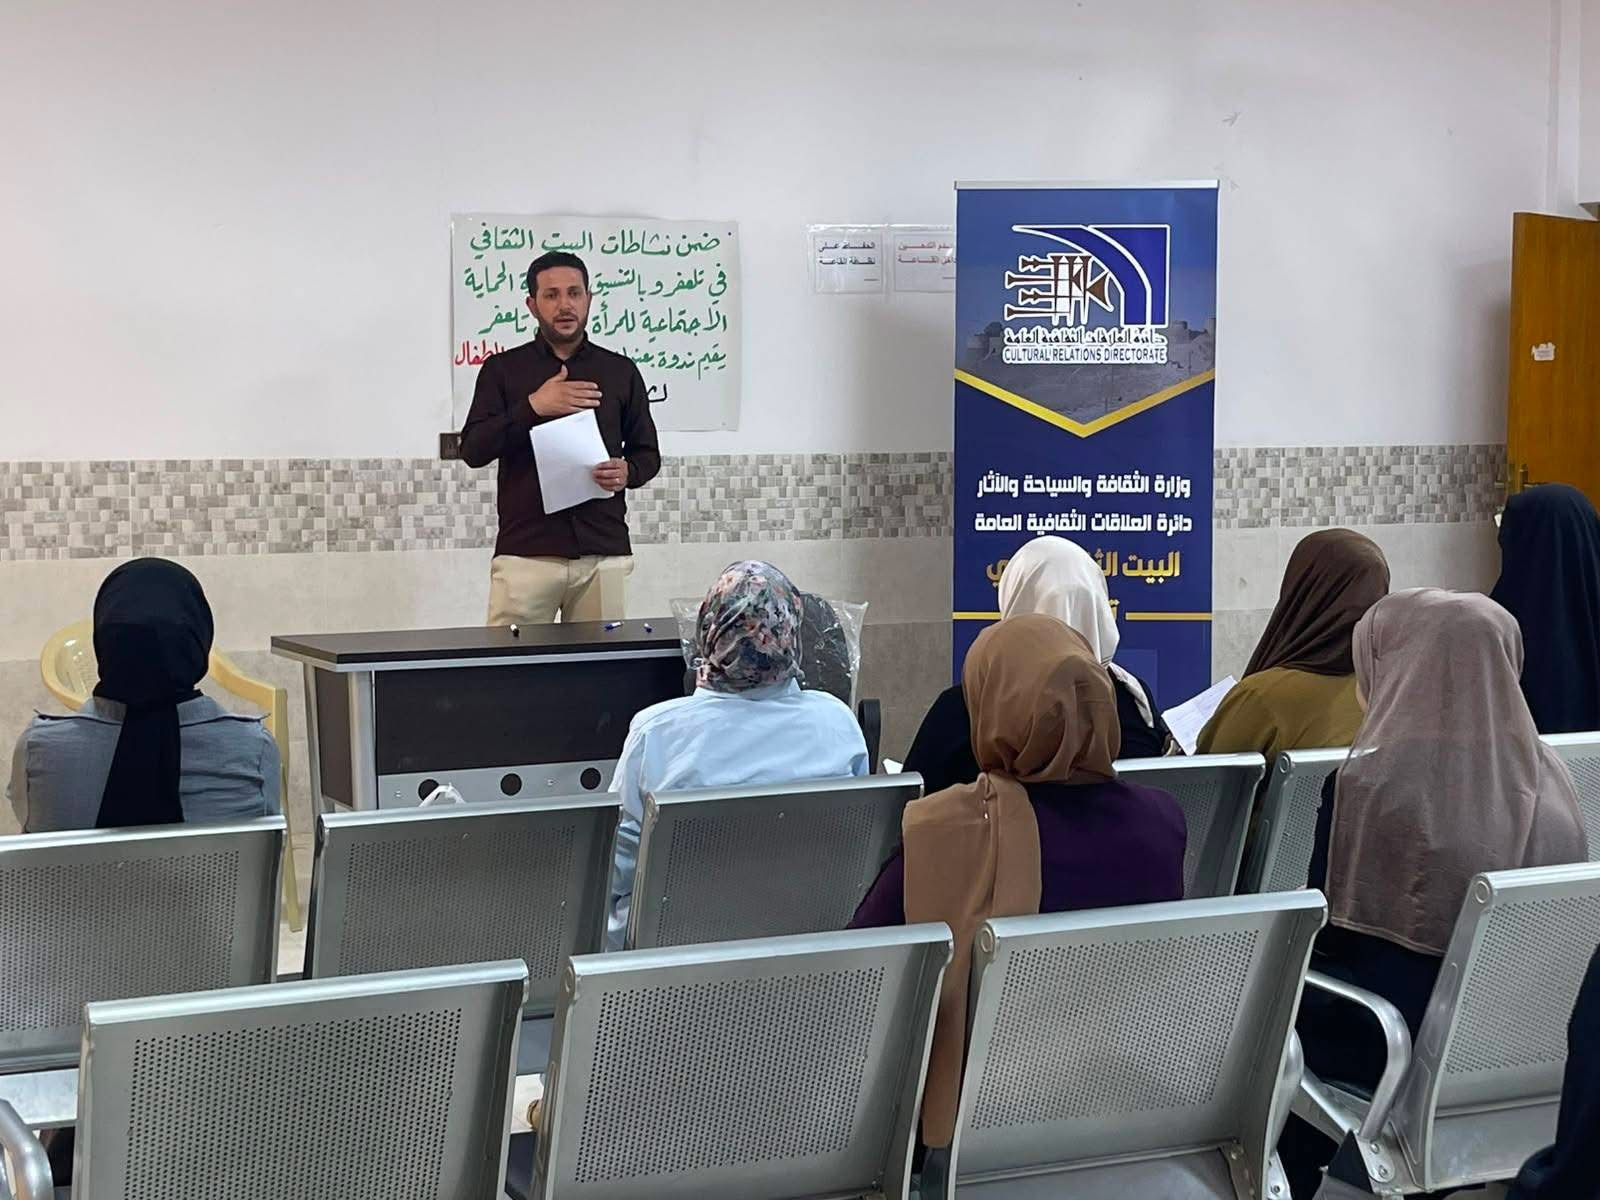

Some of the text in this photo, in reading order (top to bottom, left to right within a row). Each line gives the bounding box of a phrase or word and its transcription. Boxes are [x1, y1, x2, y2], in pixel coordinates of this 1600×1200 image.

[470, 222, 533, 260] الثقافي
[601, 229, 671, 256] نشاطات
[676, 231, 720, 257] ضمن
[464, 261, 514, 298] الحماية
[663, 268, 704, 298] تلعفر
[708, 262, 727, 305] في
[478, 305, 531, 334] تلعفر
[592, 301, 636, 336] للمرأة
[657, 351, 696, 370] ندوة
[697, 343, 727, 380] يقيم
[1004, 347, 1166, 362] CULTURAL RELATIONS DIRECTORATE
[1023, 473, 1092, 498] والسياحة
[1096, 470, 1150, 494] الثقافة
[1154, 473, 1191, 498] وزارة
[975, 509, 1192, 536] دائرة العلاقات الثقافية العامة
[1121, 551, 1181, 584] البيت
